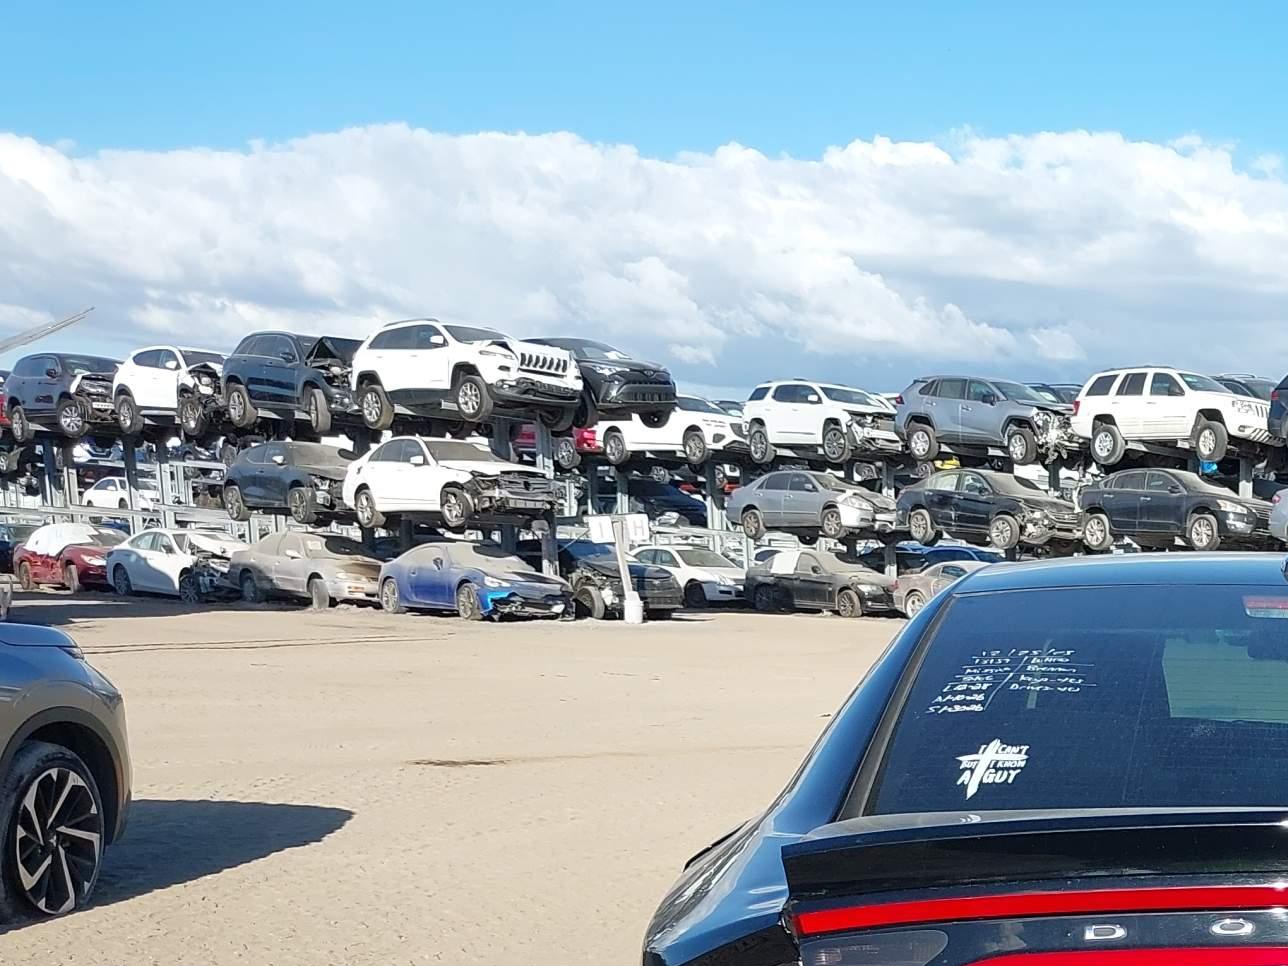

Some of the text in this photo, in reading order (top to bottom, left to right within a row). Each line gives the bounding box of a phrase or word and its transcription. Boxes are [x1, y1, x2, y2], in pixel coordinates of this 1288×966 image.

[960, 760, 978, 769] BUT
[997, 760, 1027, 768] KNOW
[956, 769, 1022, 785] A GUY
